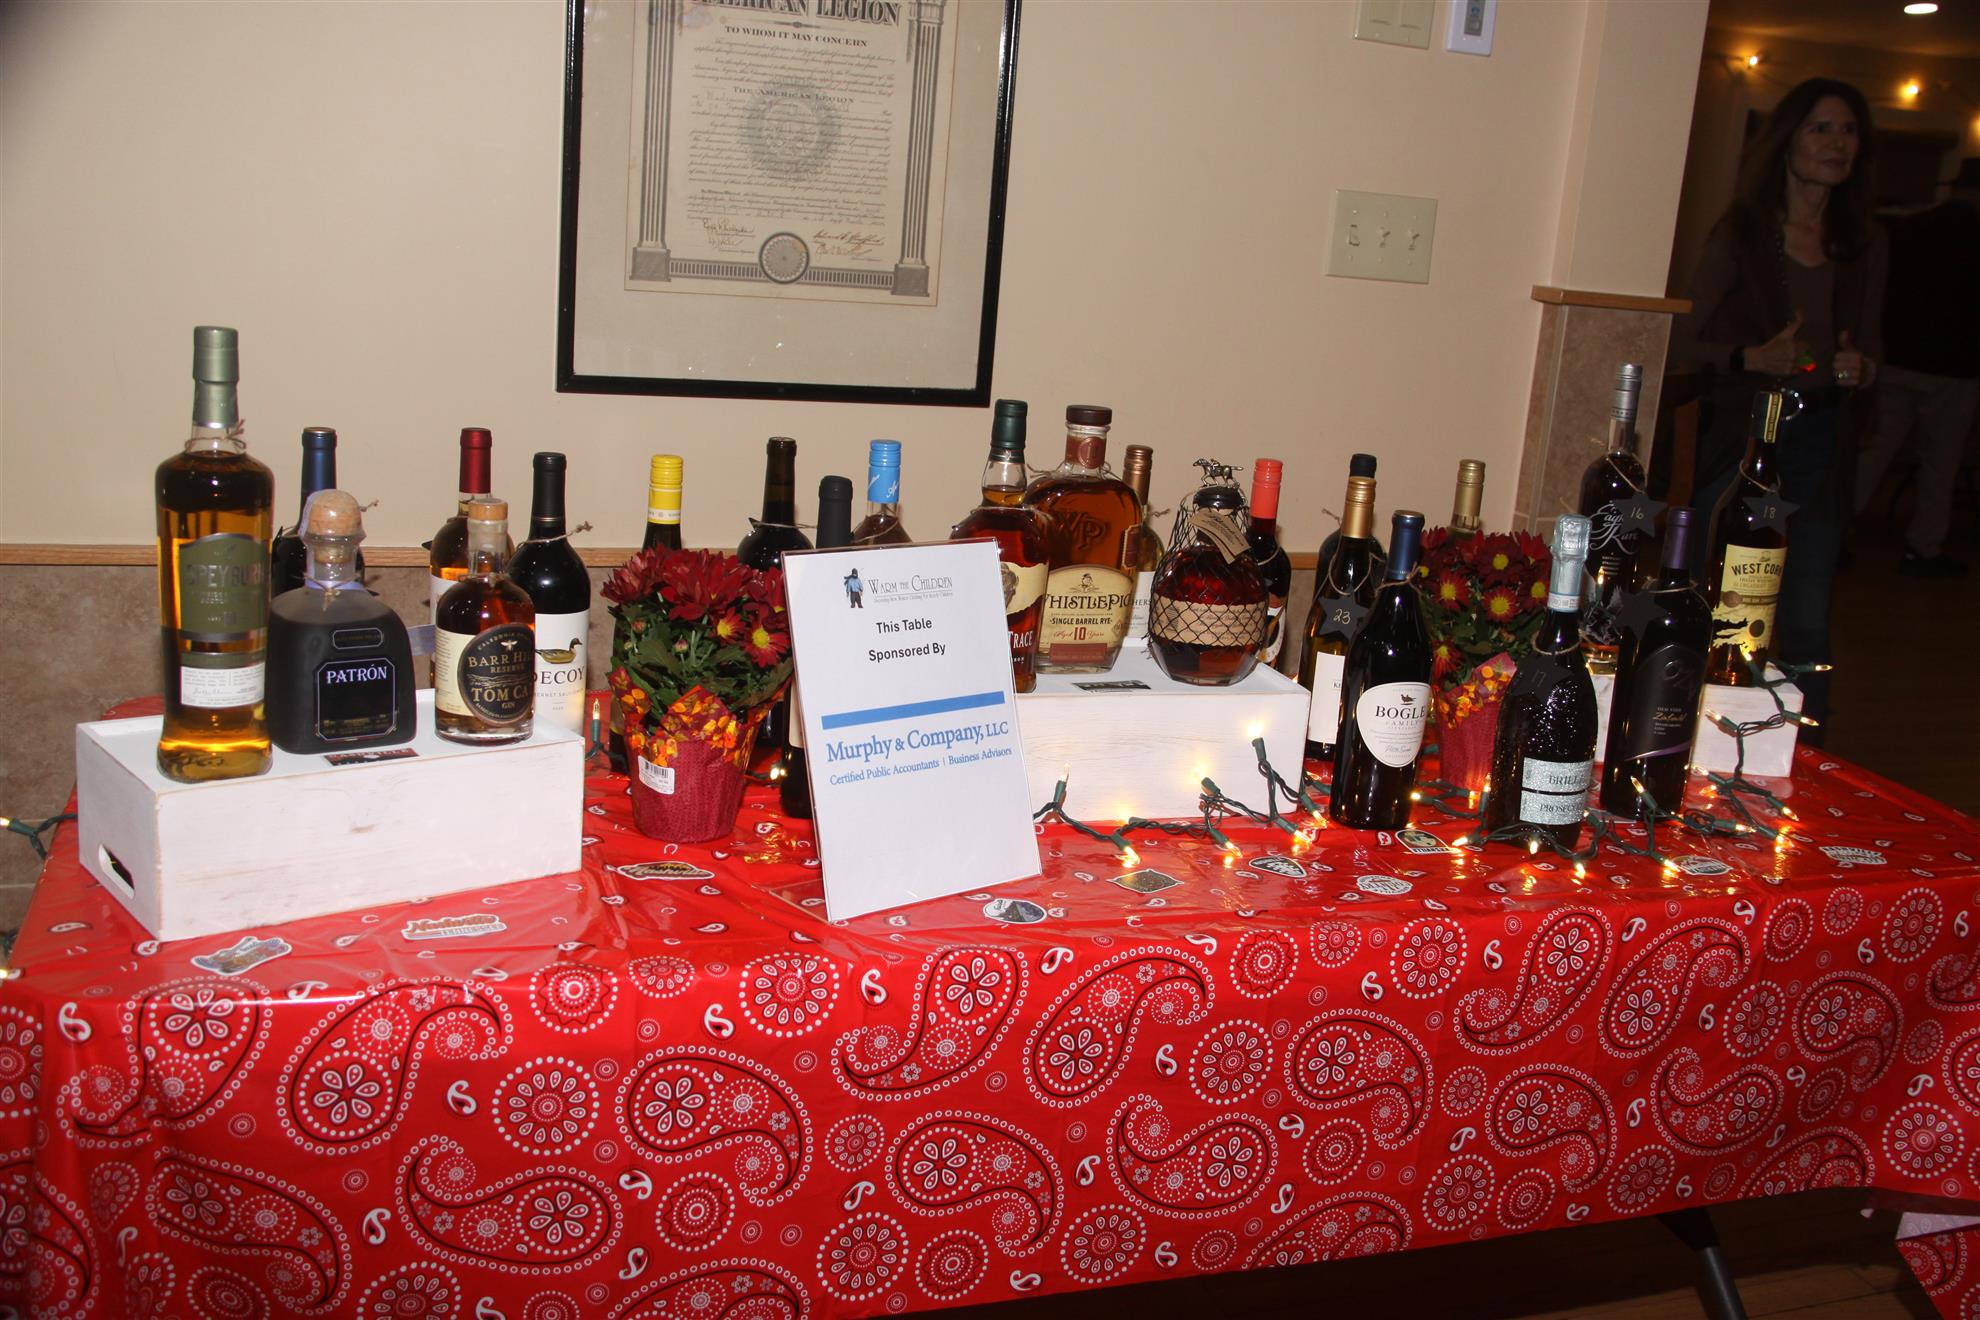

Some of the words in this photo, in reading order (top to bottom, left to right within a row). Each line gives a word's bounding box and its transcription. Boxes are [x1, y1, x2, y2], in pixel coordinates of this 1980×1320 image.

[816, 0, 901, 26] LEGION
[725, 25, 740, 33] TO
[743, 27, 776, 38] WHOM
[778, 31, 789, 39] IT
[793, 32, 811, 41] MAY
[815, 35, 867, 47] CONCERN
[733, 86, 752, 95] THE
[757, 88, 811, 100] AMERICAN
[815, 93, 855, 103] LEGION
[1630, 506, 1645, 520] 16
[1762, 505, 1777, 519] 18
[1731, 563, 1762, 577] WEST
[1764, 563, 1782, 577] COR
[868, 579, 898, 594] WARM
[911, 575, 953, 591] CHILDREN
[1052, 617, 1074, 626] SINGLE
[1075, 617, 1099, 626] BARREL
[1100, 617, 1111, 625] RYE
[1333, 608, 1351, 625] 23
[876, 621, 900, 633] This
[902, 618, 932, 631] Table
[1053, 630, 1073, 640] Aged
[1074, 627, 1086, 641] 10
[868, 643, 930, 662] Sponsored
[932, 642, 946, 656] By
[468, 654, 510, 668] BARR
[490, 663, 526, 674] RESERVE
[327, 664, 388, 684] PATRÓN
[471, 687, 508, 702] TOM
[513, 685, 529, 699] CA
[1375, 705, 1427, 720] BOGLE
[826, 735, 892, 762] Murphy
[895, 738, 904, 751] &
[907, 725, 984, 749] Company,
[987, 721, 1009, 737] LLC
[830, 771, 865, 785] Certified
[866, 767, 891, 779] Public
[893, 759, 940, 774] Accountants
[948, 753, 980, 765] Business
[982, 747, 1012, 760] Advisors
